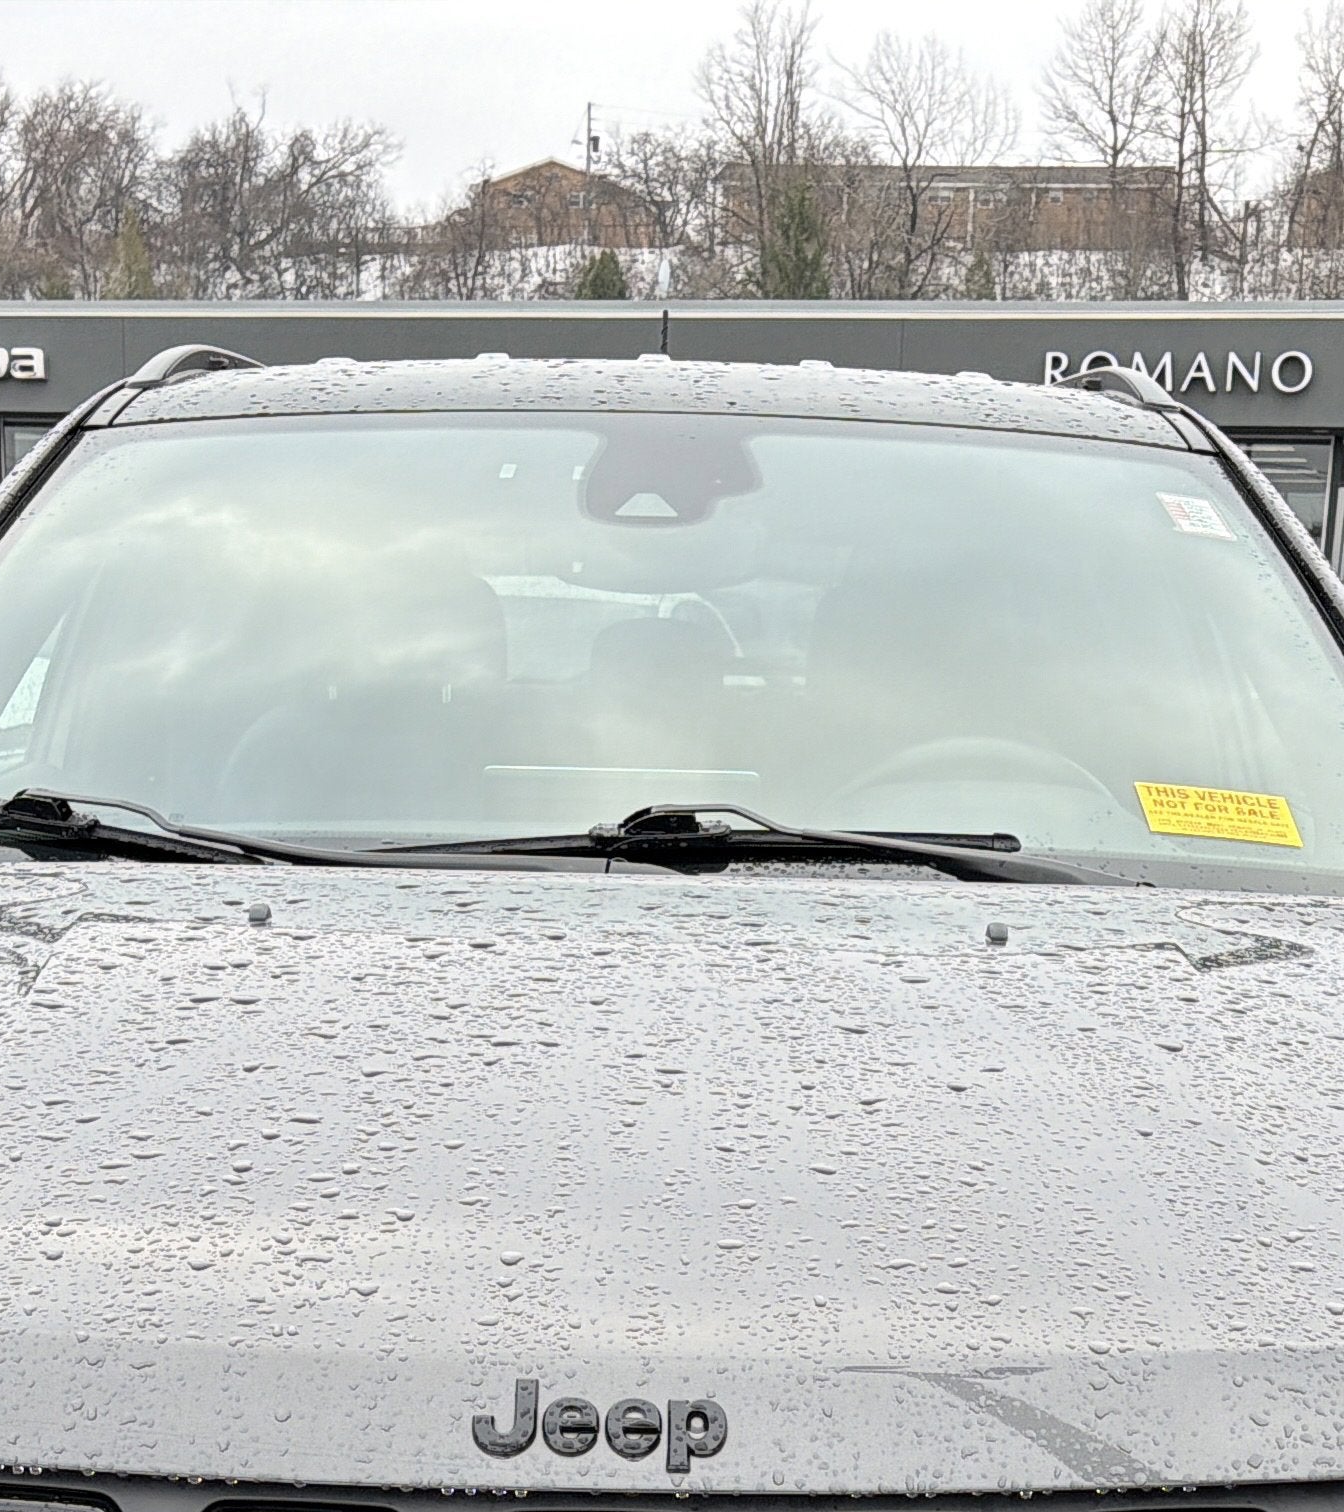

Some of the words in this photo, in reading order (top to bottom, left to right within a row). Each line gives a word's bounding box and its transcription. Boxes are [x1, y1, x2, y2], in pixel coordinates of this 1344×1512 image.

[1143, 785, 1190, 800] THIS
[1194, 790, 1280, 810] VEHICLE
[1152, 798, 1187, 810] NOT
[1194, 802, 1230, 814] FOR
[1235, 806, 1281, 820] SALE
[472, 1378, 727, 1473] Jeep
